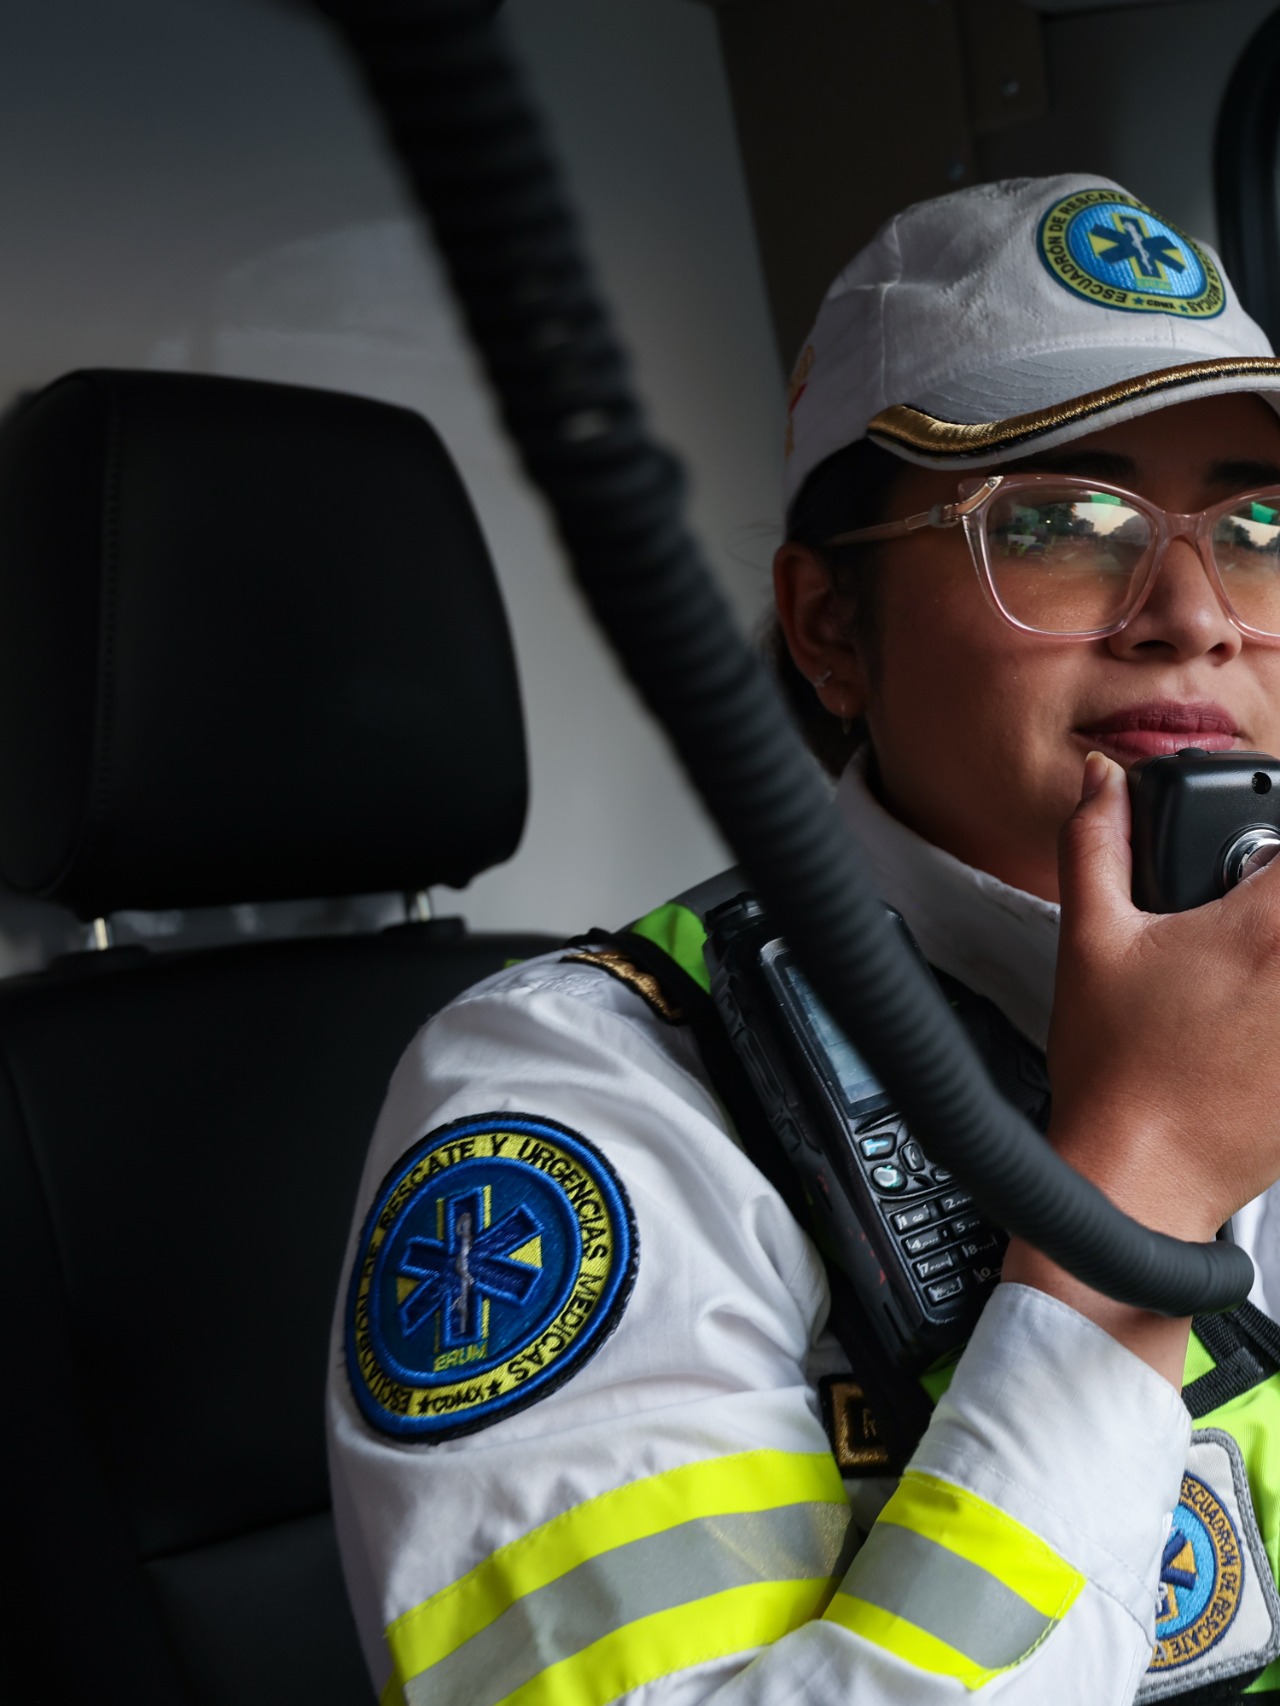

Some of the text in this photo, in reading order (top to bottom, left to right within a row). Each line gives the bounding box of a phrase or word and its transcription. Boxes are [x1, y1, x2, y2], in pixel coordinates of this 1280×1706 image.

[1049, 216, 1066, 232] DE
[1059, 192, 1128, 215] RESCATE
[490, 1133, 509, 1158] Y
[378, 1138, 476, 1231] RESCATE
[517, 1137, 608, 1261] URGENCIAS
[507, 1272, 605, 1381] MEDICAS
[433, 1342, 488, 1373] ERUM
[432, 1385, 484, 1412] CDMX
[1219, 1572, 1238, 1595] DE
[1169, 1597, 1232, 1659] RESCATE
